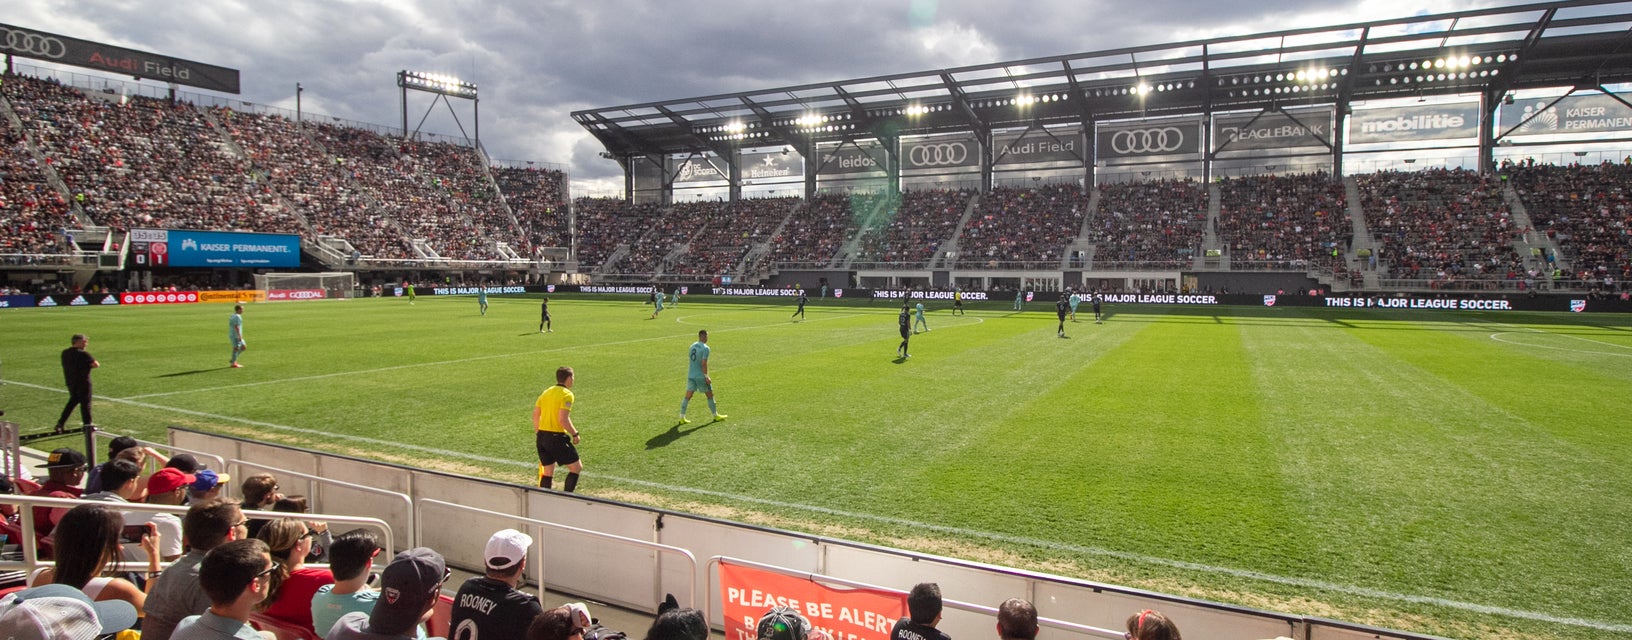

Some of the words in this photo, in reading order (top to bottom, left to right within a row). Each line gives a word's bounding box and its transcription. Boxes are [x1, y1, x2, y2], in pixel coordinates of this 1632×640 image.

[89, 52, 138, 70] Audi
[144, 61, 190, 79] Field
[1566, 106, 1606, 118] KAISER
[1361, 114, 1464, 133] mobilitie
[1000, 143, 1035, 155] Audi
[1038, 140, 1074, 152] Field
[838, 155, 877, 168] leidos
[751, 168, 788, 178] Heineken
[200, 243, 231, 252] KAISER
[157, 254, 163, 264] 1
[898, 291, 924, 299] MJOR
[925, 291, 954, 299] LEAGUE
[1077, 293, 1092, 302] HIS
[1104, 294, 1136, 303] MAJOR
[1138, 295, 1175, 303] LEAGUE
[1176, 295, 1218, 304] SOCCER.
[1325, 297, 1351, 307] THIS
[1353, 298, 1365, 307] IS
[1410, 299, 1457, 309] LEAGUE
[1460, 300, 1512, 310] SOCCER.
[690, 348, 697, 361] 8
[460, 593, 498, 616] ROONEY
[727, 587, 802, 614] PLEASE
[805, 602, 834, 619] BE
[838, 607, 898, 635] ALERT
